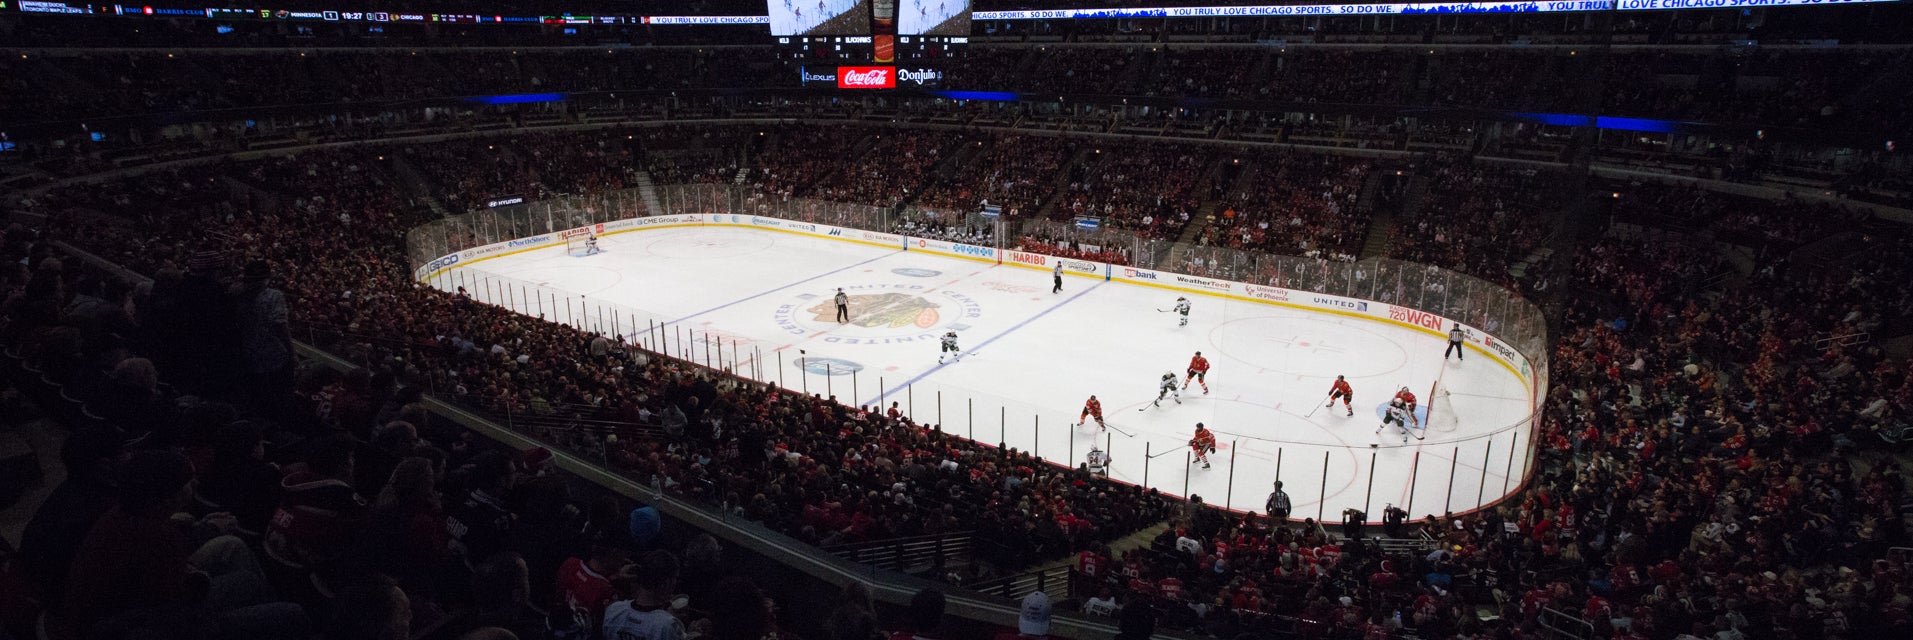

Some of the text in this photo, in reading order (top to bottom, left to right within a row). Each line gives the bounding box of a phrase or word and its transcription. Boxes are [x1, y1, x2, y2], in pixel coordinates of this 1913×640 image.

[1223, 7, 1247, 15] LOVE
[1250, 7, 1292, 15] CHICAGO
[1295, 6, 1334, 14] SPORTS.
[1357, 5, 1373, 13] DO
[1376, 5, 1395, 13] WE.
[1549, 2, 1575, 10] YOU
[1623, 0, 1657, 8] LOVE
[1662, 0, 1726, 8] CHICAGO
[845, 70, 888, 85] Coca-Cola
[498, 198, 523, 206] HYUNDAI
[659, 217, 678, 225] Group
[512, 235, 550, 247] NorthShore
[430, 254, 458, 272] GEICO
[1013, 252, 1045, 266] HARIBO
[1177, 276, 1231, 289] WeatherTech
[1256, 287, 1288, 297] University
[1264, 294, 1288, 302] Phoenix
[942, 291, 981, 318] CENTER
[1313, 297, 1355, 309] UNITED
[774, 304, 805, 335] CENTER
[1390, 309, 1442, 331] 720 WGN
[824, 333, 935, 345] UNITED
[1491, 337, 1516, 361] impact
[447, 515, 469, 539] SHARP
